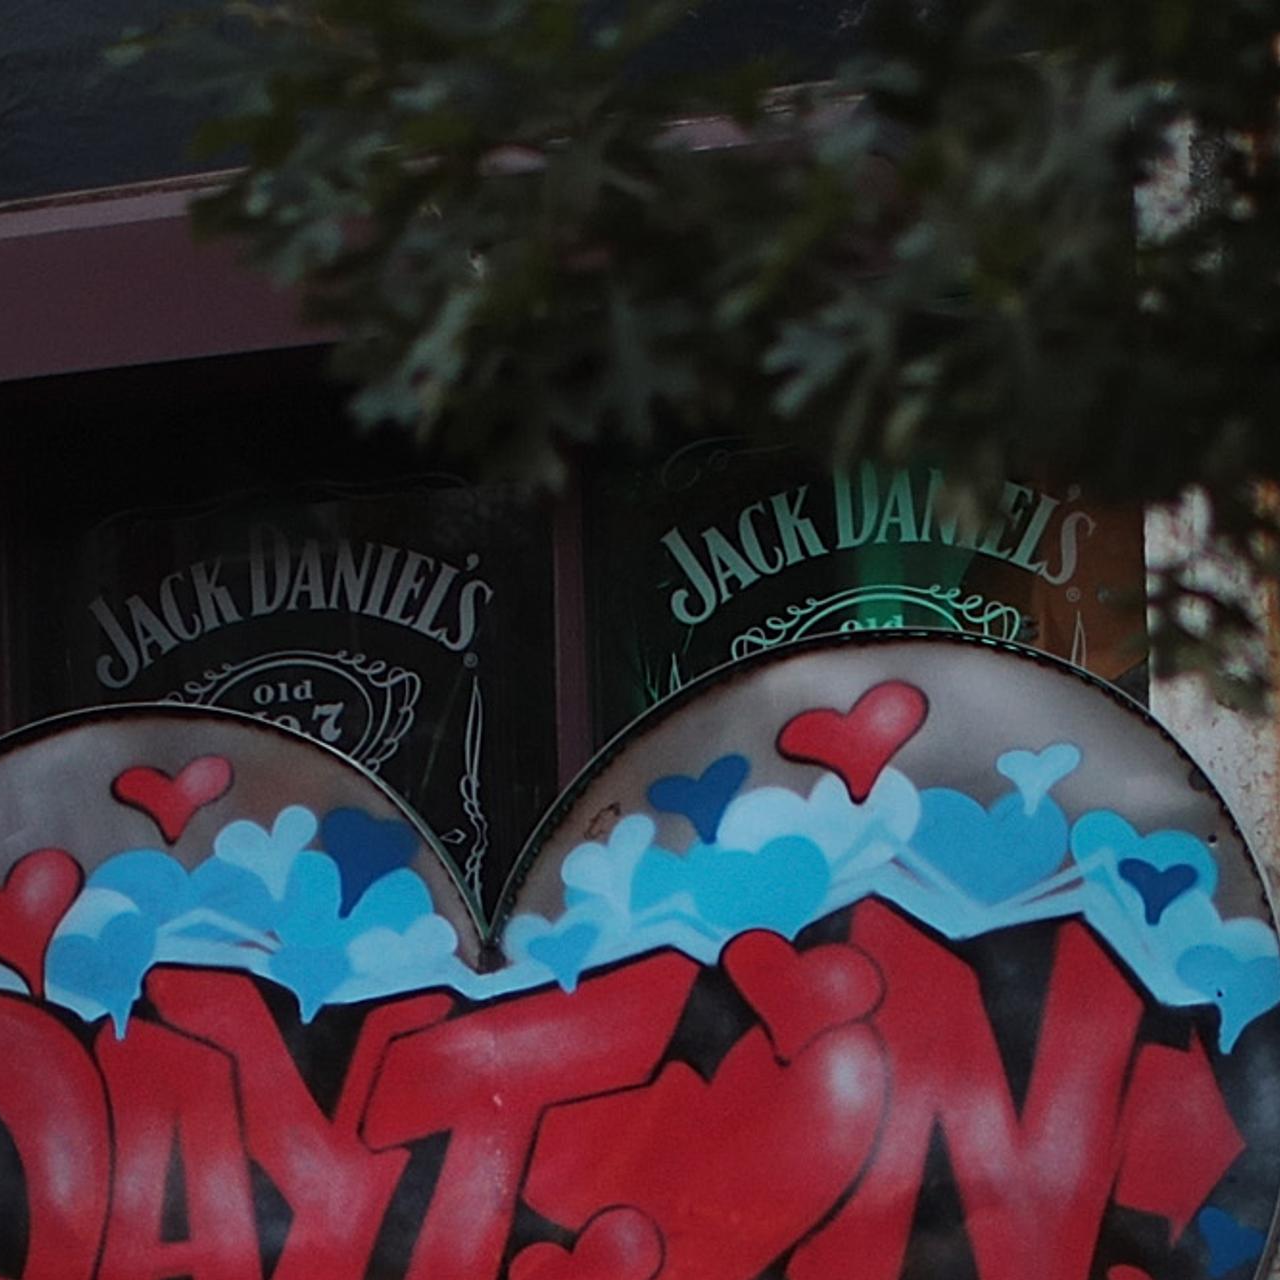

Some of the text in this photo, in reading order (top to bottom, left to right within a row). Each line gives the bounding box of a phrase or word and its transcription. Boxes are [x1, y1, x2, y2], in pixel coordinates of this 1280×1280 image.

[87, 521, 494, 689] JACK DANIEL'S
[659, 482, 830, 626] JACK
[252, 678, 314, 706] Old
